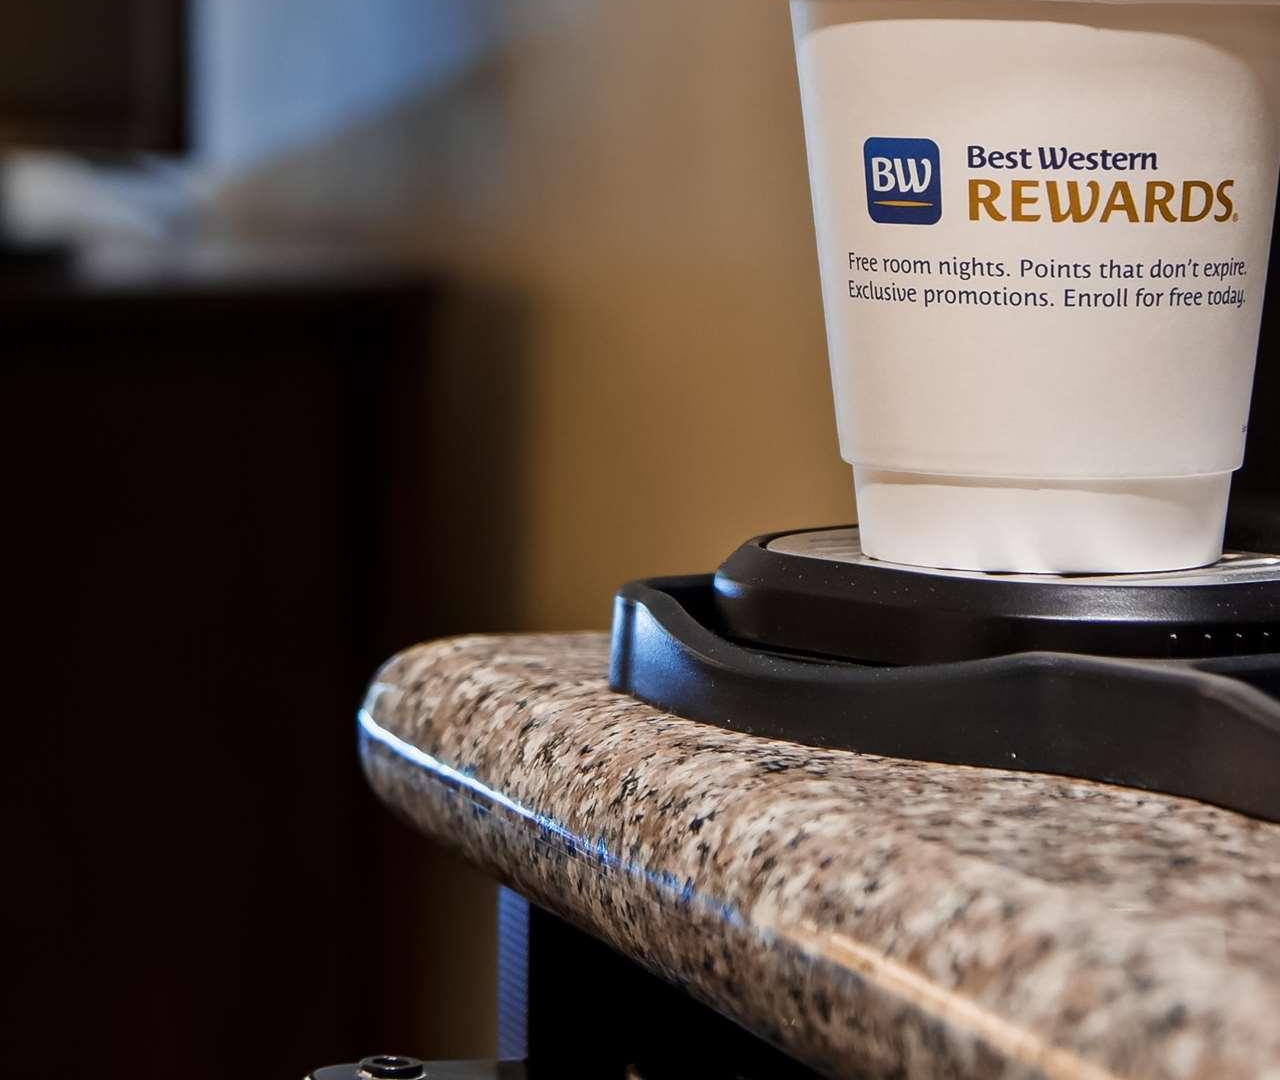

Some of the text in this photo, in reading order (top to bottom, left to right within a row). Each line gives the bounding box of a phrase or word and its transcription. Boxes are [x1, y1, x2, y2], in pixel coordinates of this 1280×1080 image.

[967, 145, 1158, 170] Best Western
[871, 157, 932, 193] BW
[848, 252, 1248, 281] Free room nights. Points that don't expire.
[848, 280, 1247, 309] Exclusive promotions. Enroll for free today.
